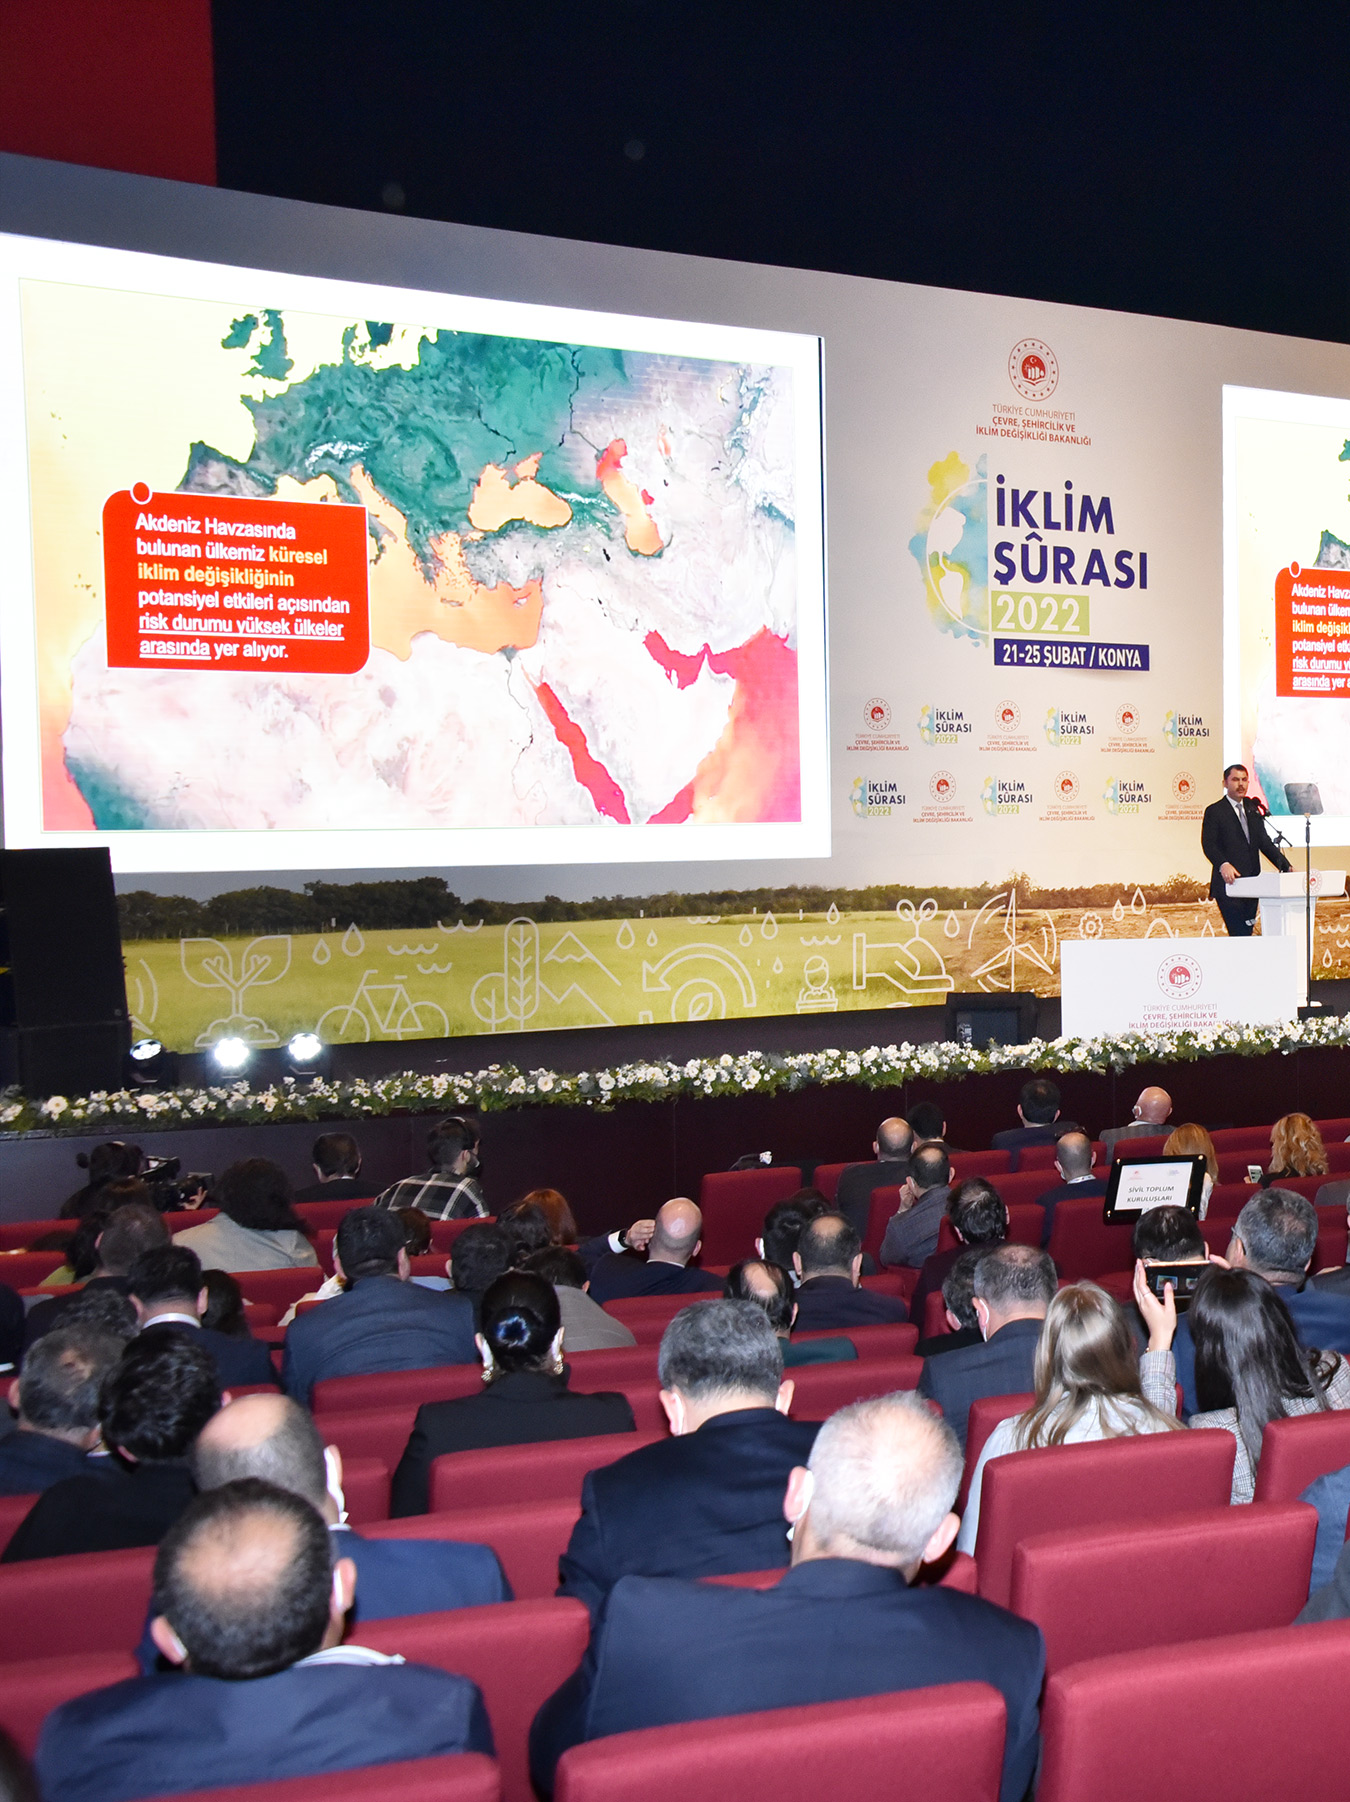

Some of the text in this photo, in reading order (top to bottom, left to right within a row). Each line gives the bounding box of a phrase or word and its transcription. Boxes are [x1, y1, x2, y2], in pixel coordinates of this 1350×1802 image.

[992, 404, 1075, 420] TÜRKİYE CUMHURİYETİ
[992, 416, 1076, 432] ÇEVRE, ŞEHİRCİLİK VE
[976, 425, 1092, 446] İKLİM DEĞİŞİKLİĞİ BAKANLIĞI
[996, 474, 1115, 535] İKLİM
[135, 512, 296, 540] Akdeniz Havzasında
[136, 537, 328, 565] bulunan ülkemiz küresel
[993, 532, 1148, 590] ŞÛRASI
[138, 562, 294, 588] iklim değişikliğinin
[1292, 583, 1326, 598] Akdeniz
[138, 589, 350, 614] potansiyel etkileri açısından
[1292, 601, 1326, 616] bulunan
[996, 594, 1080, 632] 2022
[139, 612, 344, 637] risk durumu yüksek ülkeler
[1292, 620, 1314, 632] iklim
[140, 638, 288, 661] arasında yer alıyor.
[1292, 639, 1336, 655] potansiyel
[1003, 644, 1040, 664] 21-25
[1044, 646, 1086, 666] ŞUBAT
[1099, 648, 1142, 668] KONYA
[1292, 656, 1308, 669] risk
[1310, 656, 1342, 670] durumu
[1292, 674, 1330, 688] arasında
[1332, 677, 1346, 690] yer
[936, 708, 964, 720] İKLİM
[1060, 712, 1086, 722] İKLİM
[1178, 714, 1202, 726] İKLİM
[936, 734, 958, 743] 2022
[1060, 736, 1080, 744] 2022
[1178, 738, 1196, 746] 2022
[868, 780, 897, 792] İKLİM
[998, 780, 1025, 792] İKLİM
[1119, 780, 1144, 792] İKLİM
[868, 806, 890, 816] 2022
[998, 805, 1019, 814] 2022
[1118, 804, 1138, 814] 2022
[1150, 1020, 1192, 1028] DEĞİŞİKLİĞİ
